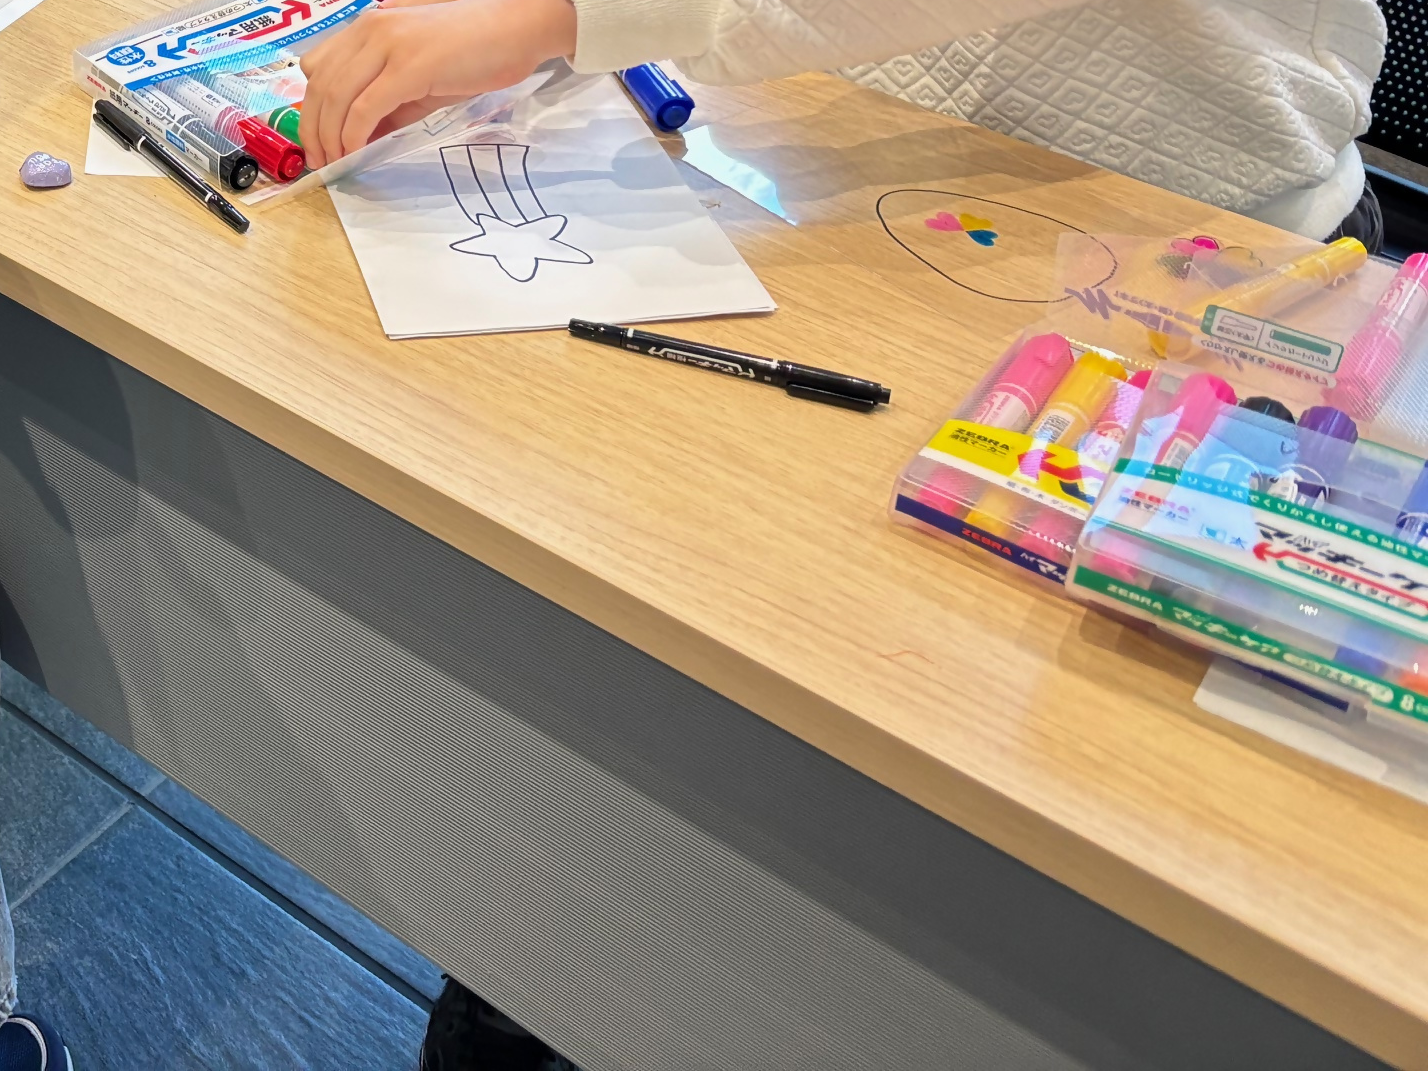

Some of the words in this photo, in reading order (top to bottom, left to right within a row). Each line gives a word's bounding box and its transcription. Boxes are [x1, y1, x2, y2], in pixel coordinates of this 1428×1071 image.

[190, 15, 275, 46] 紙用マッキー
[143, 59, 157, 68] 8
[950, 434, 1007, 457] 油性マーカー
[955, 428, 1010, 451] ZEBRA
[962, 528, 1012, 556] ZEBRA
[1106, 584, 1163, 611] ZEBRA
[1400, 694, 1415, 712] 8
